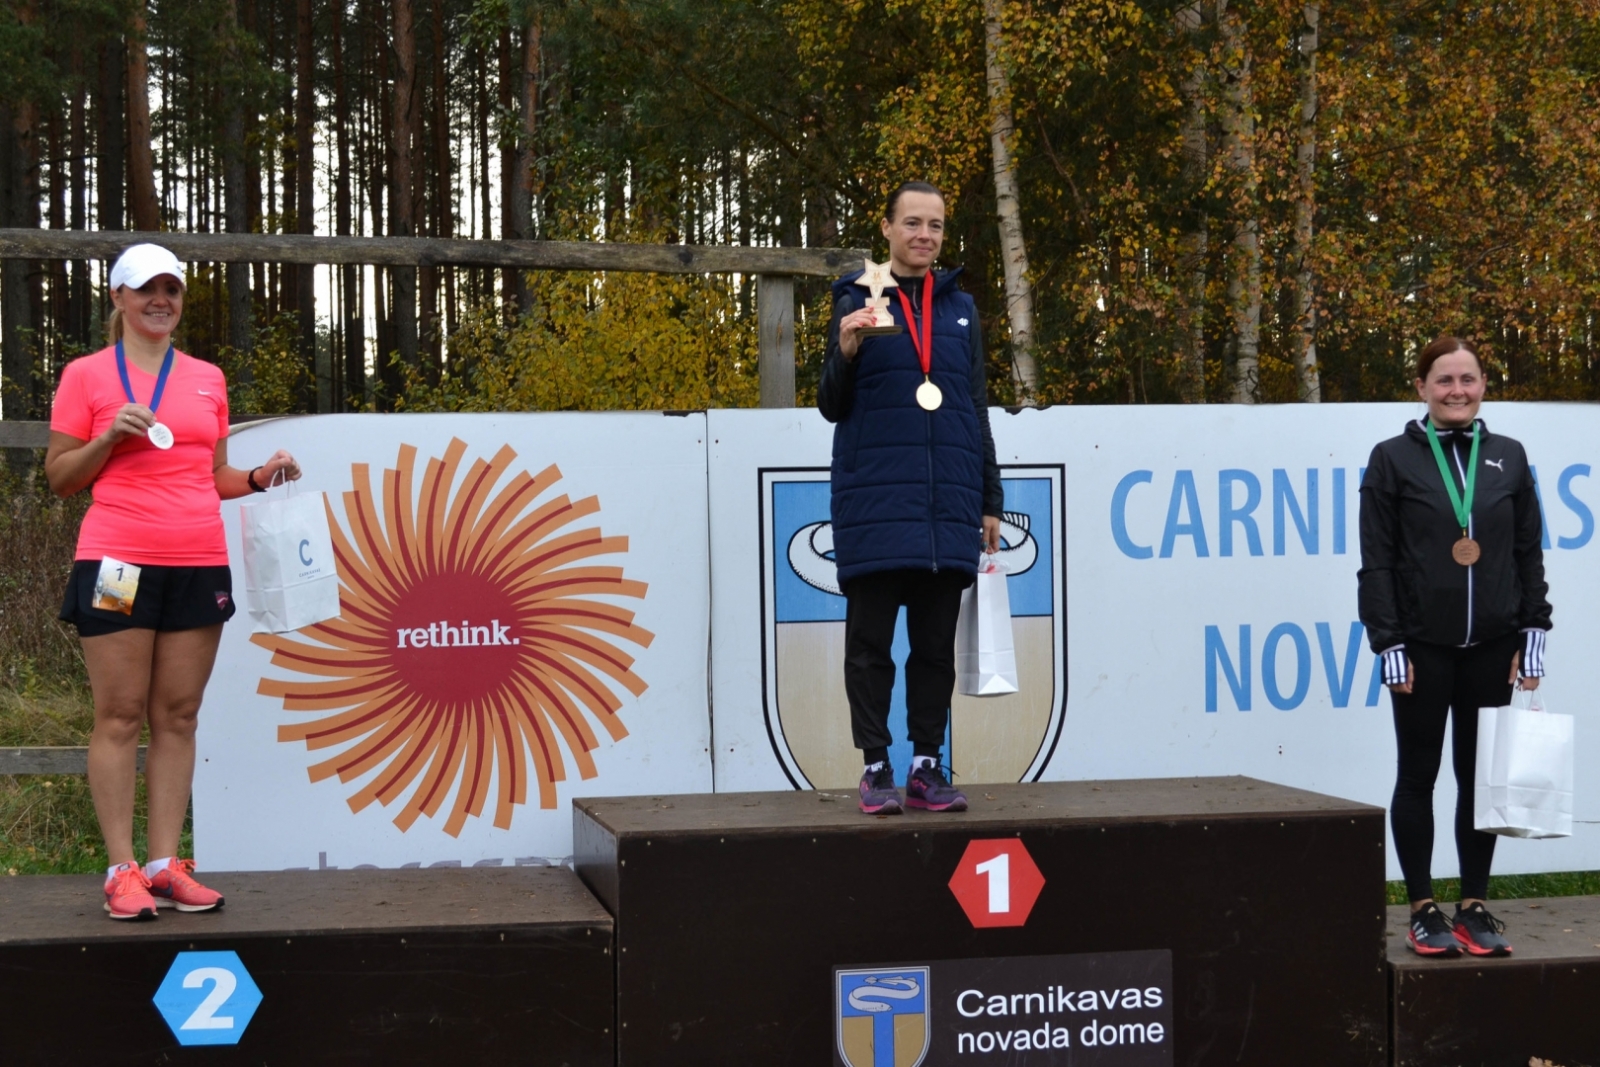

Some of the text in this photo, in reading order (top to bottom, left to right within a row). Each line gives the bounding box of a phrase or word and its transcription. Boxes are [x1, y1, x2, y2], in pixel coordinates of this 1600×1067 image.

[1110, 463, 1595, 560] CARNIS
[299, 538, 313, 567] C
[116, 567, 123, 581] 1
[396, 619, 520, 649] rethink.
[1205, 621, 1382, 713] NOV
[975, 853, 1010, 913] 1
[180, 967, 237, 1029] 2
[956, 985, 1163, 1017] Carnikavas
[958, 1019, 1165, 1053] novada dome
